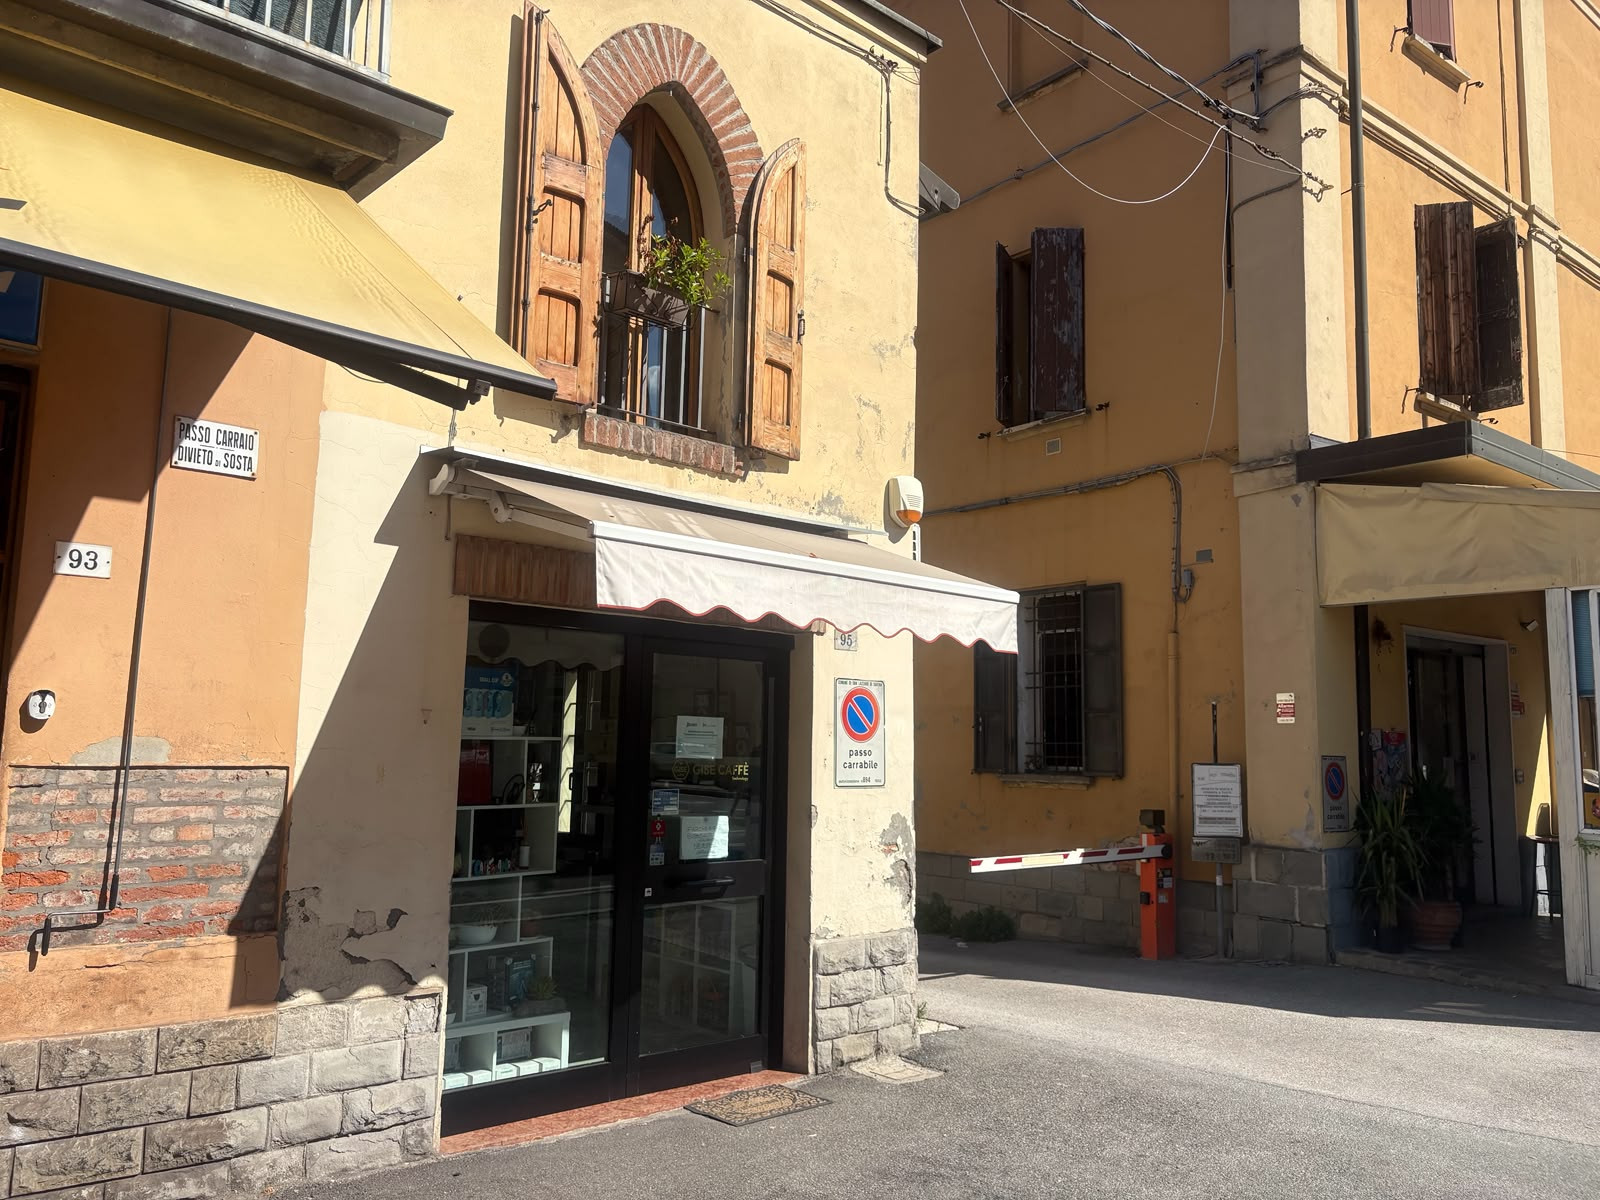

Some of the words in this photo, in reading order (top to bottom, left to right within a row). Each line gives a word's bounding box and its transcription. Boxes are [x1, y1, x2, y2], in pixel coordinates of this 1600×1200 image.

[178, 422, 211, 443] PASSO
[215, 428, 255, 451] CARRAIO
[177, 445, 213, 466] DIVIETO
[223, 452, 253, 472] SOSTA
[68, 548, 98, 570] 93
[840, 633, 853, 646] 95
[848, 749, 873, 758] passo
[842, 760, 879, 769] carrabile
